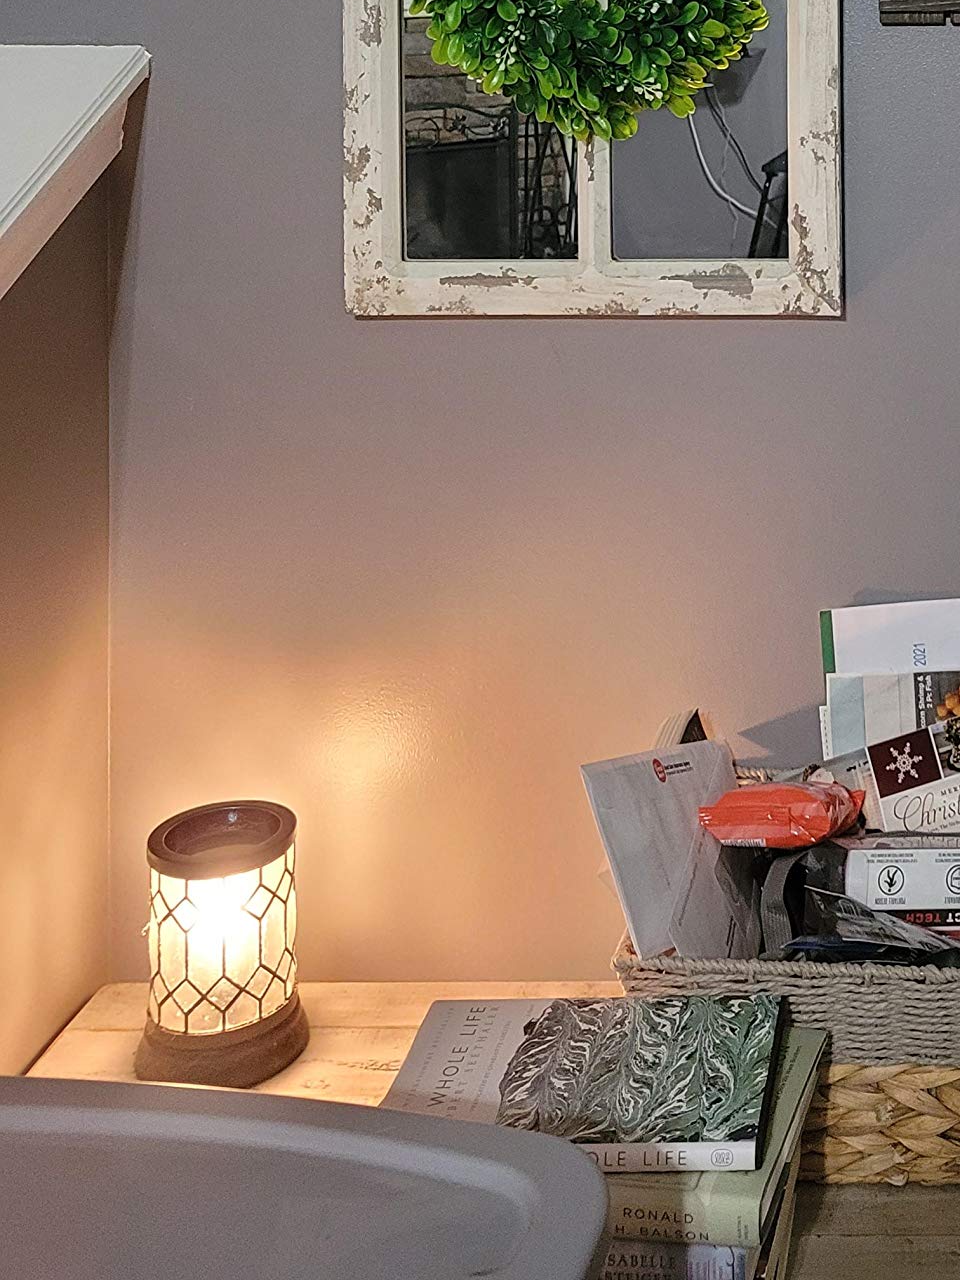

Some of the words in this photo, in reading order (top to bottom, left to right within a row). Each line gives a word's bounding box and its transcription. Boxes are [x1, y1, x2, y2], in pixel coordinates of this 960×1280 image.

[913, 642, 926, 667] 2021
[925, 675, 933, 691] Fish
[918, 683, 926, 709] Shrimp
[427, 1046, 468, 1107] WHOLE
[459, 1007, 486, 1036] LIFE
[643, 1151, 687, 1166] LIFE
[623, 1207, 694, 1224] RONALD
[615, 1225, 631, 1236] H.
[640, 1227, 710, 1241] BALSON
